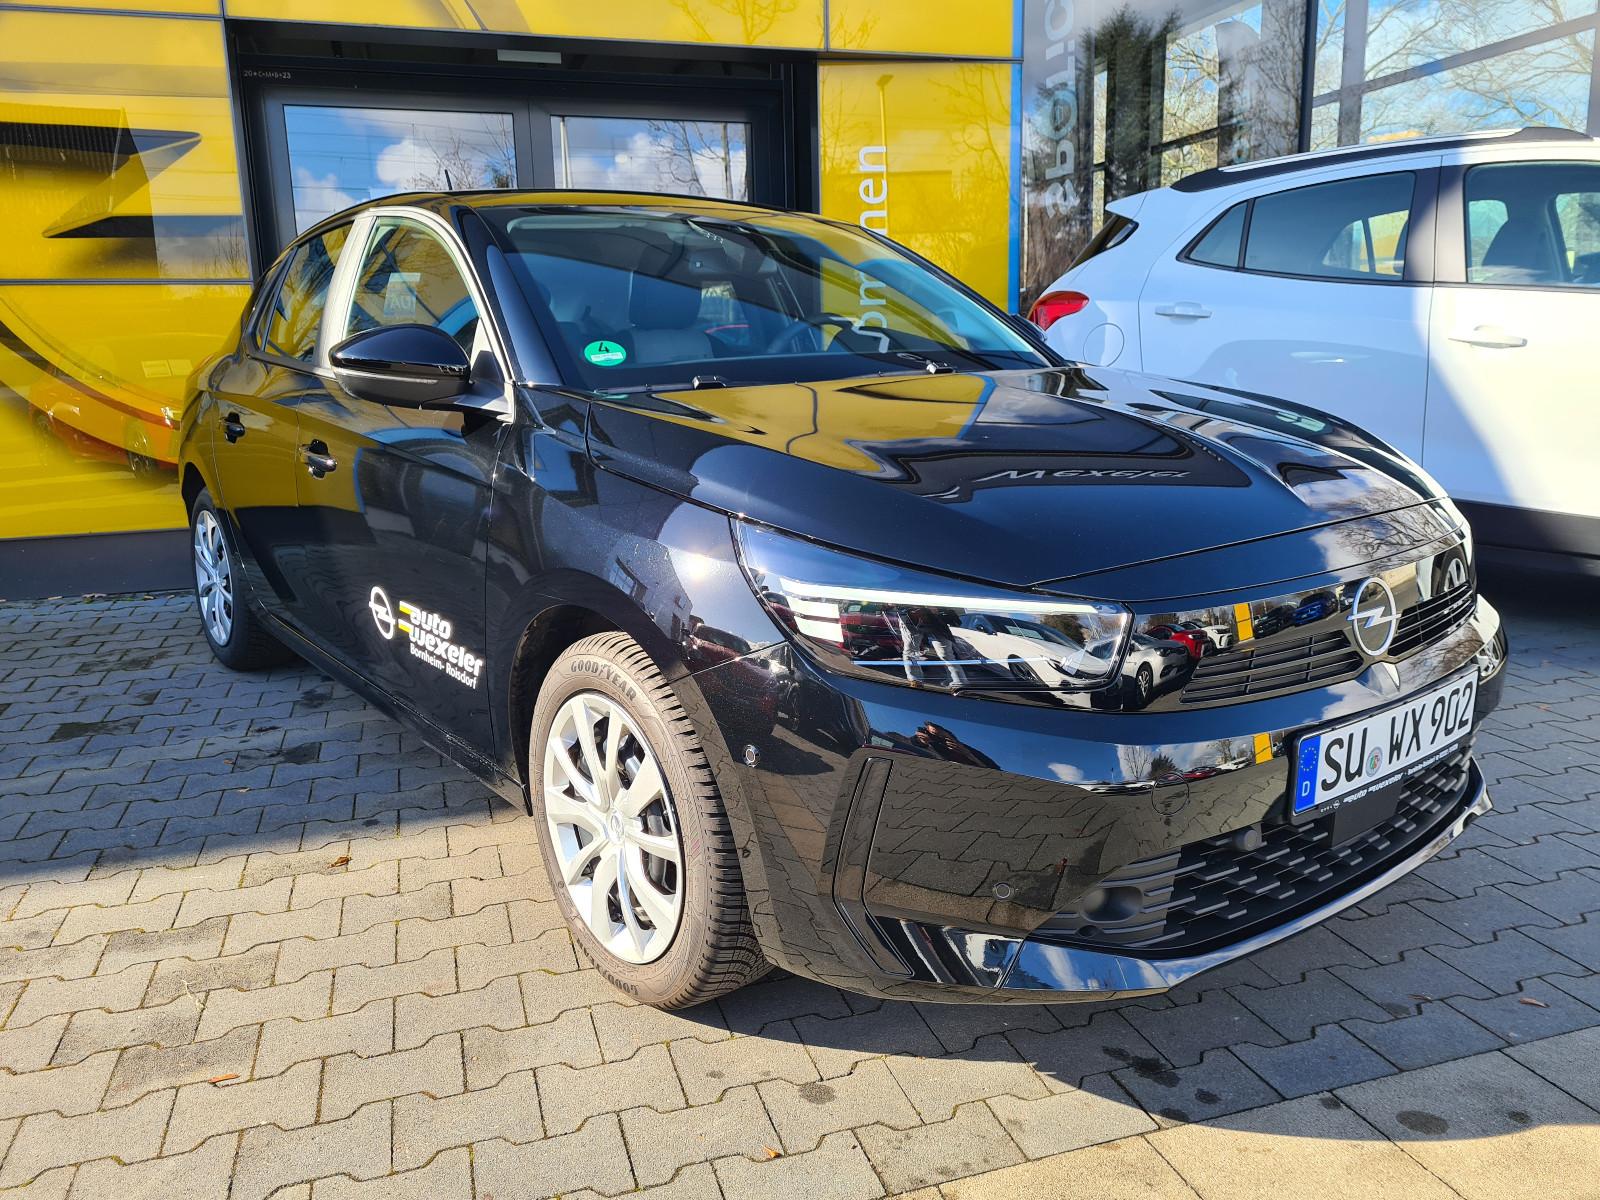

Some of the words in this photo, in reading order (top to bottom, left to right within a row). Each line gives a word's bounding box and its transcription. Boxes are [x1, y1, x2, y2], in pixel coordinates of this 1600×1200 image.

[405, 604, 452, 640] auto
[1301, 780, 1311, 797] D
[1320, 727, 1368, 792] SU
[1388, 703, 1427, 766] WX
[1430, 681, 1473, 746] 902
